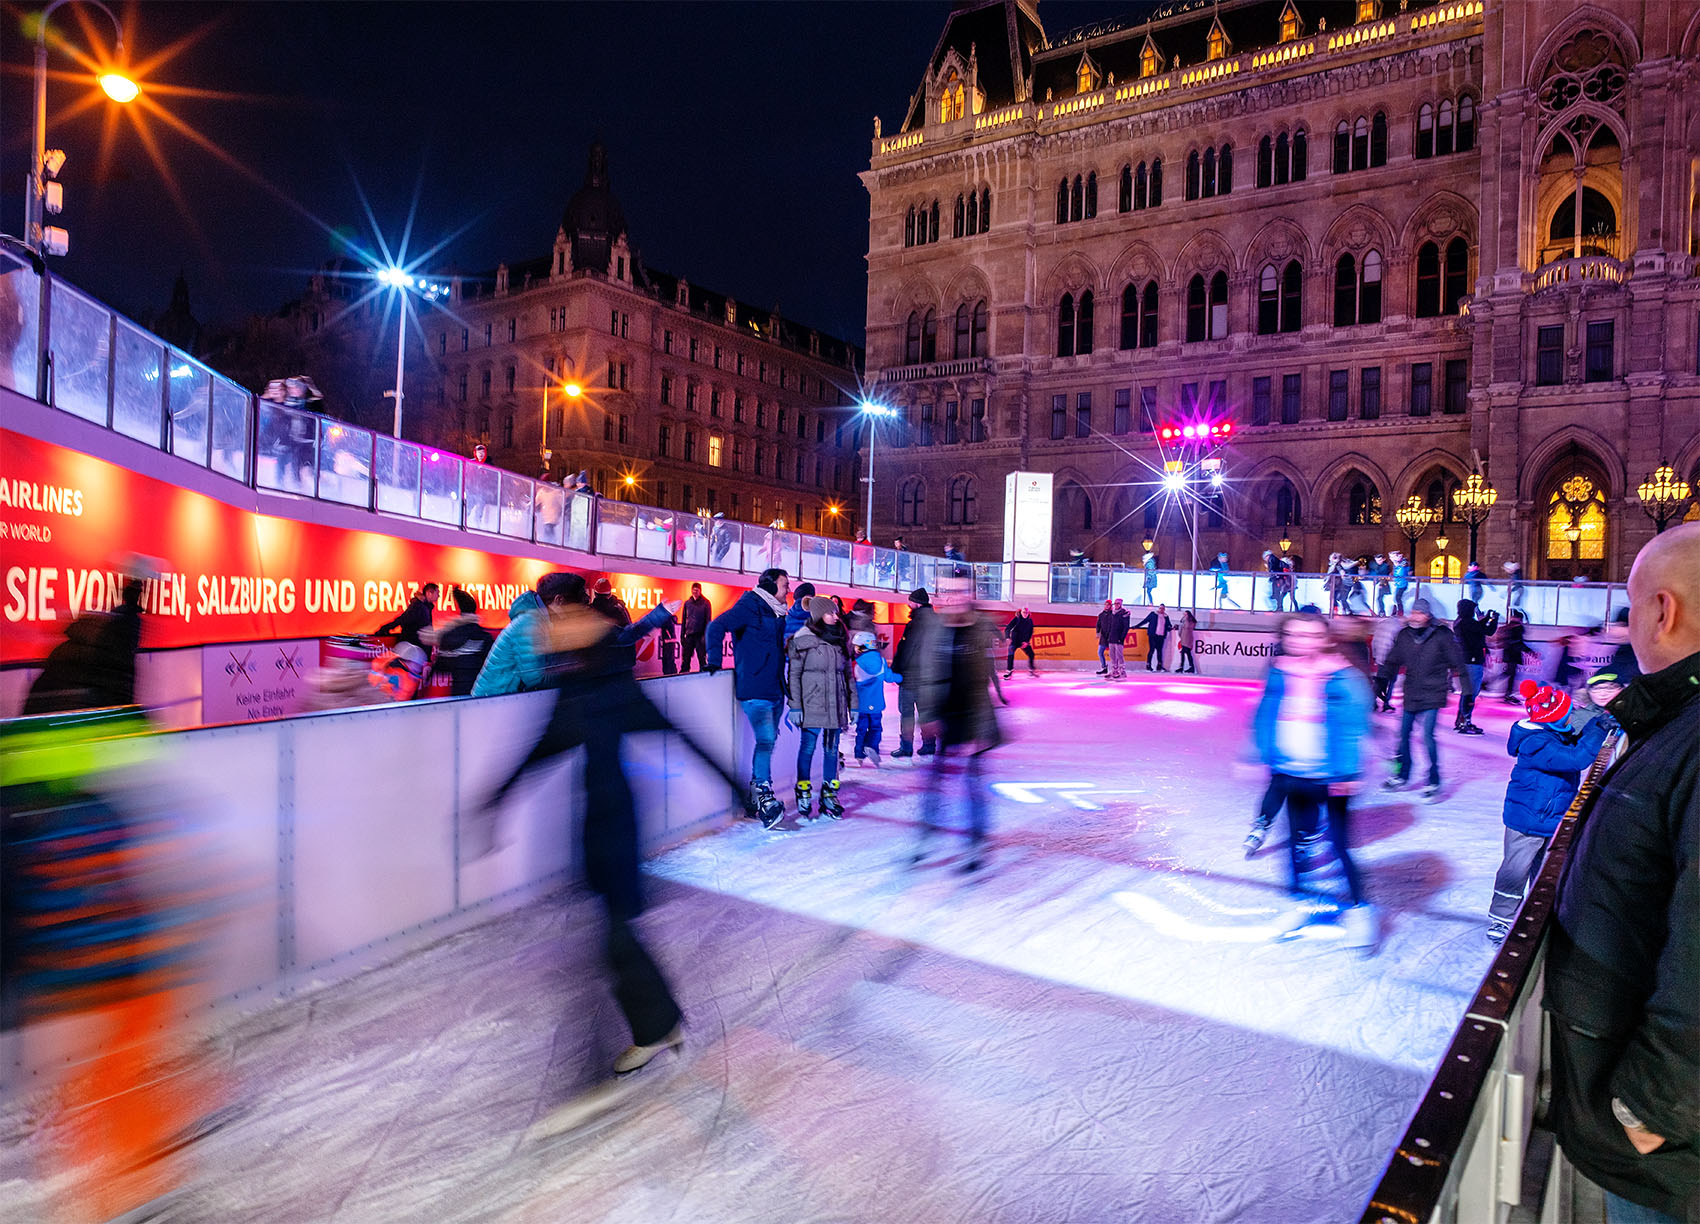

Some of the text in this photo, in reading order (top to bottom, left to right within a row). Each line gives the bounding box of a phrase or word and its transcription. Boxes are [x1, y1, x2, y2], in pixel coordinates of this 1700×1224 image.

[0, 477, 83, 516] AIRLINES
[9, 522, 52, 542] WORLD
[4, 566, 58, 622] SIE
[66, 568, 124, 619] VON
[197, 574, 296, 616] SALZBURG
[305, 579, 356, 613] UND
[621, 587, 663, 609] WELT
[1034, 633, 1064, 647] BILLA
[1195, 640, 1230, 655] Bank
[236, 692, 260, 706] Keine
